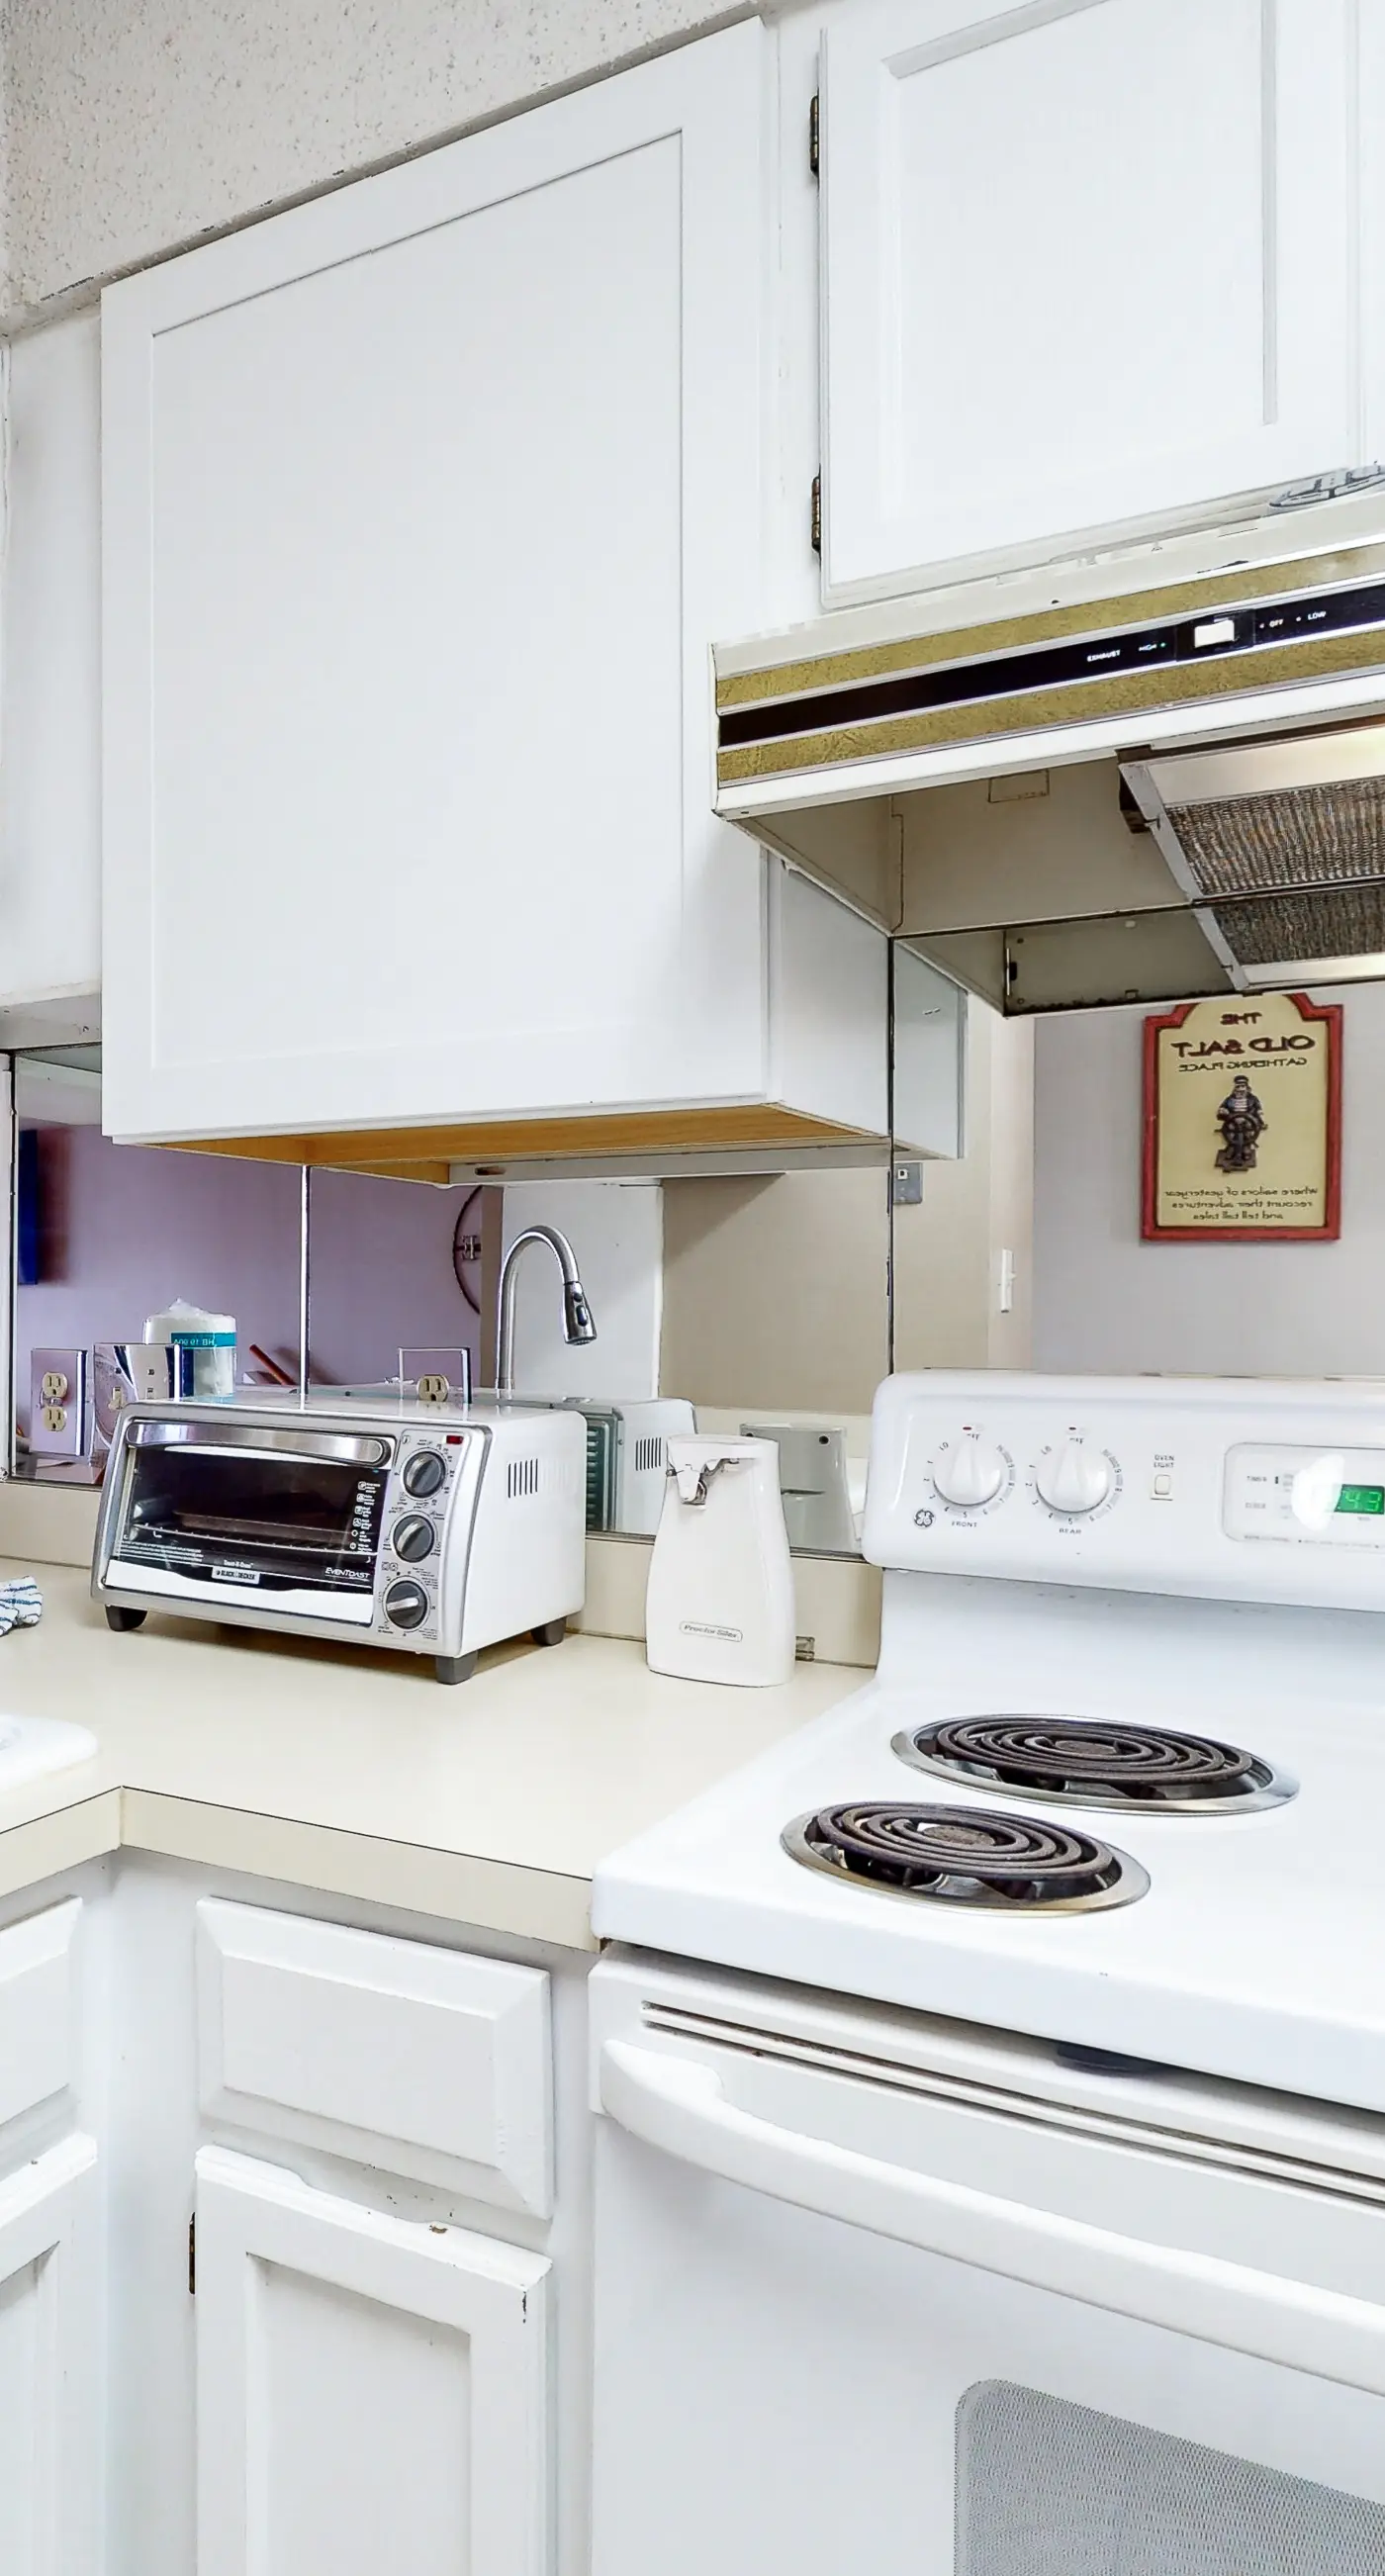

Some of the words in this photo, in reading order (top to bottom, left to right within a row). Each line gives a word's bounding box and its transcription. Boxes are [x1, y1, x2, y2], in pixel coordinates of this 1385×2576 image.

[1307, 610, 1327, 620] LOW
[1269, 618, 1284, 627] OFF
[1086, 649, 1121, 662] EXHAUST
